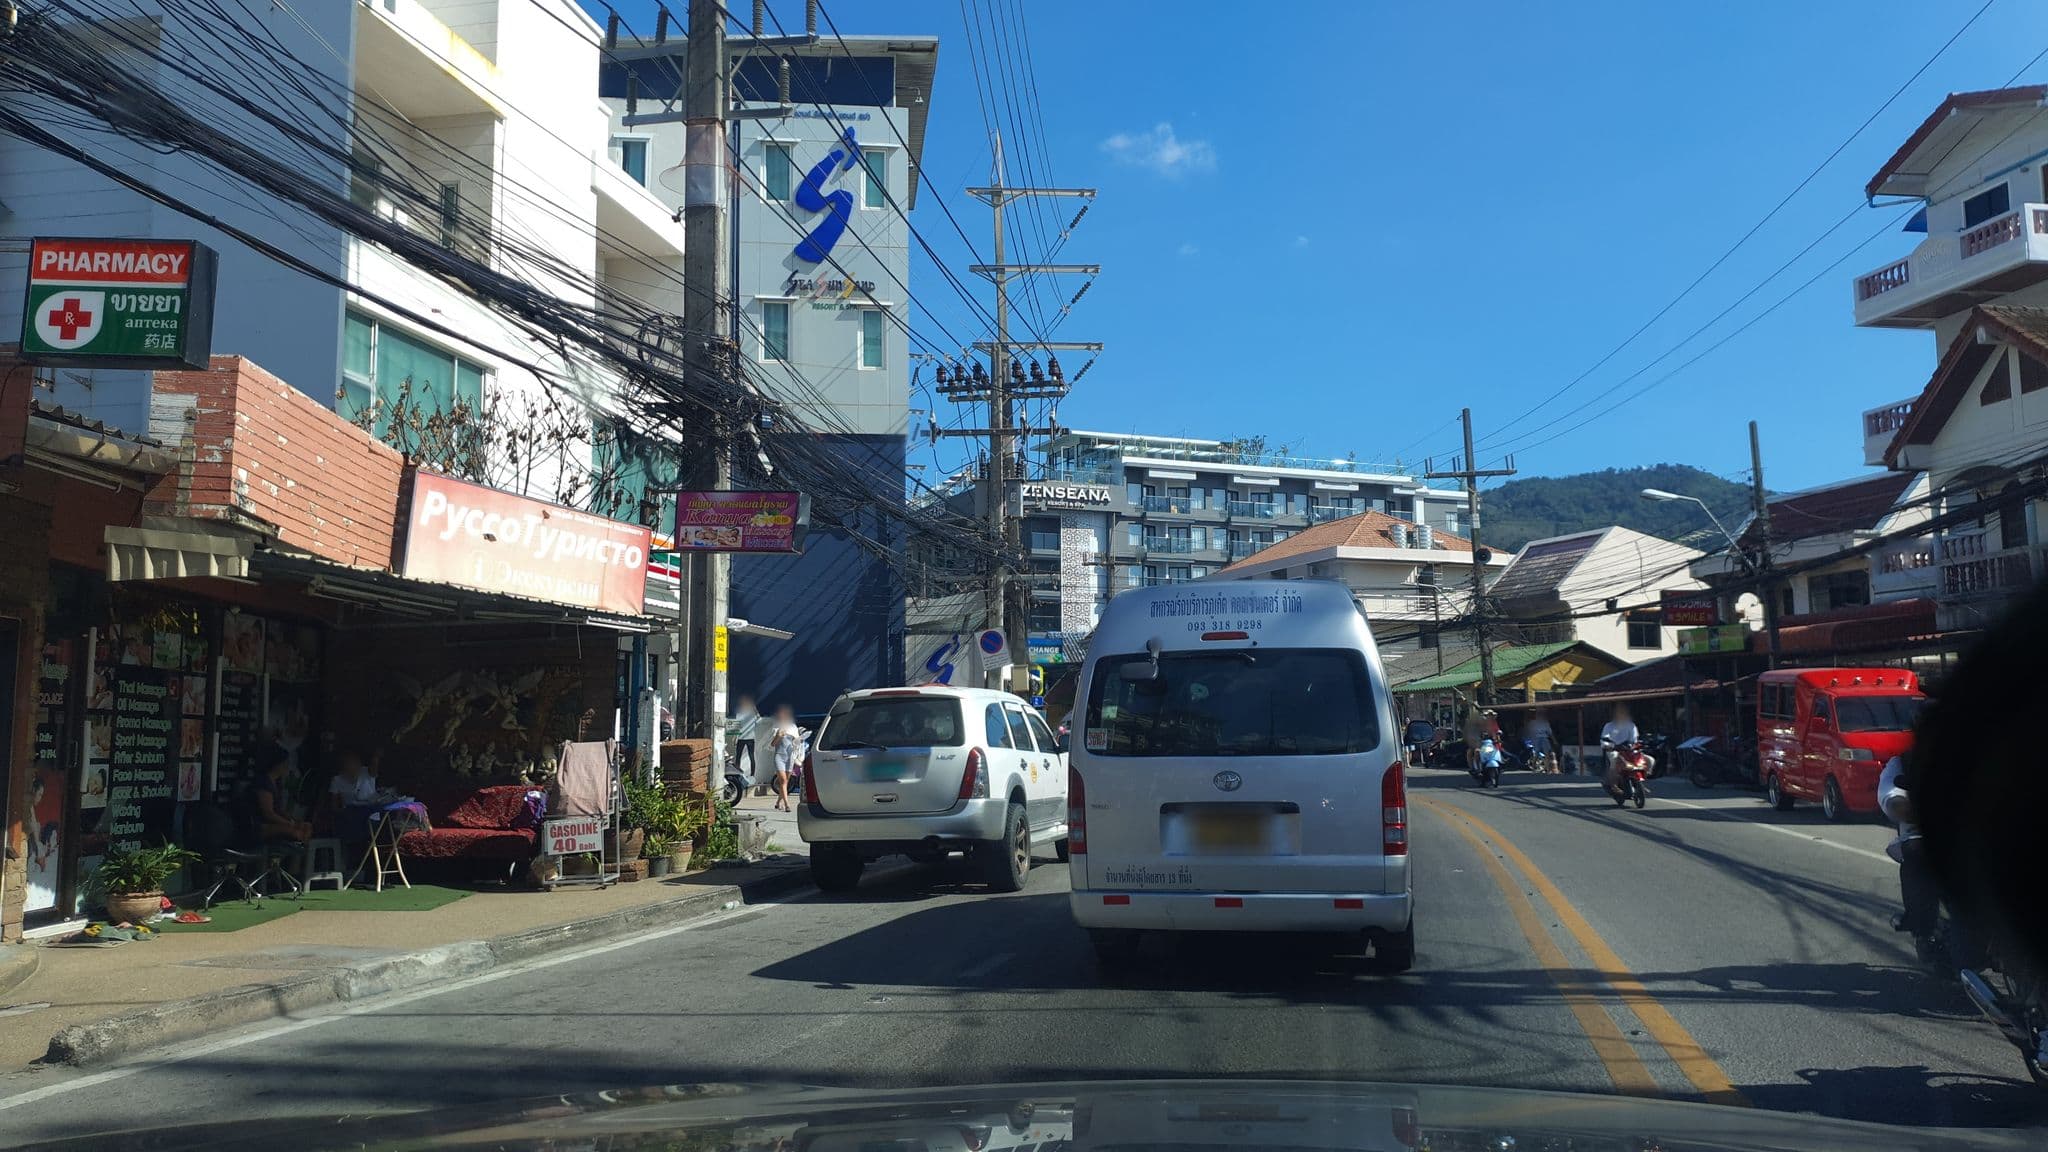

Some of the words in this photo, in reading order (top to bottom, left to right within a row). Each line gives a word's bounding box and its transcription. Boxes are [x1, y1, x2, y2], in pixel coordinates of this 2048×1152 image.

[40, 251, 184, 274] PHARMACY
[110, 293, 181, 314] ขายยา
[125, 319, 178, 329] аптека
[144, 333, 176, 349] 药店
[1022, 485, 1111, 502] ZENSEANA
[419, 489, 643, 569] РуссоТуристо
[1187, 621, 1206, 632] 093
[1212, 620, 1231, 631] 318
[1237, 619, 1262, 630] 9298
[119, 680, 135, 694] Thai
[116, 715, 140, 729] Aroma
[115, 733, 135, 748] Sport
[550, 823, 598, 838] GASOLINE
[553, 838, 577, 852] 40
